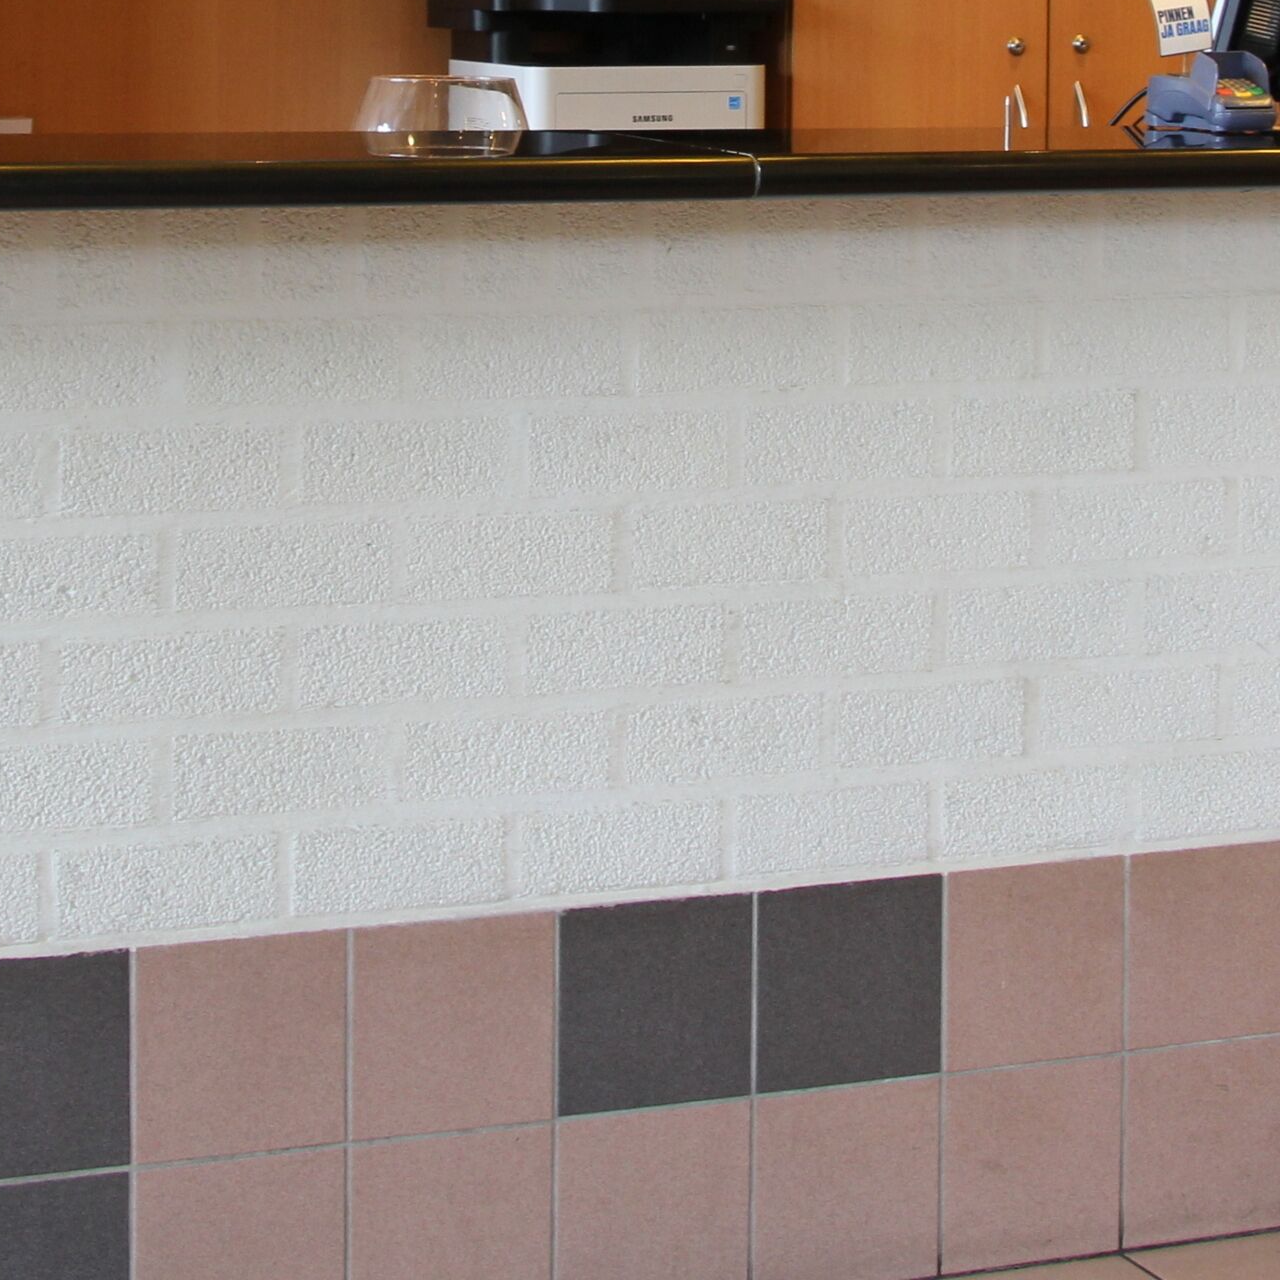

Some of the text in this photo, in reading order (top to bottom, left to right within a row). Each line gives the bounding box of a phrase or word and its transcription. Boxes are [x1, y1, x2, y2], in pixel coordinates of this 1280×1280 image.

[1157, 6, 1194, 24] PINNEN
[1161, 19, 1209, 38] JA GRAAG
[632, 115, 673, 123] SAMSUNG
